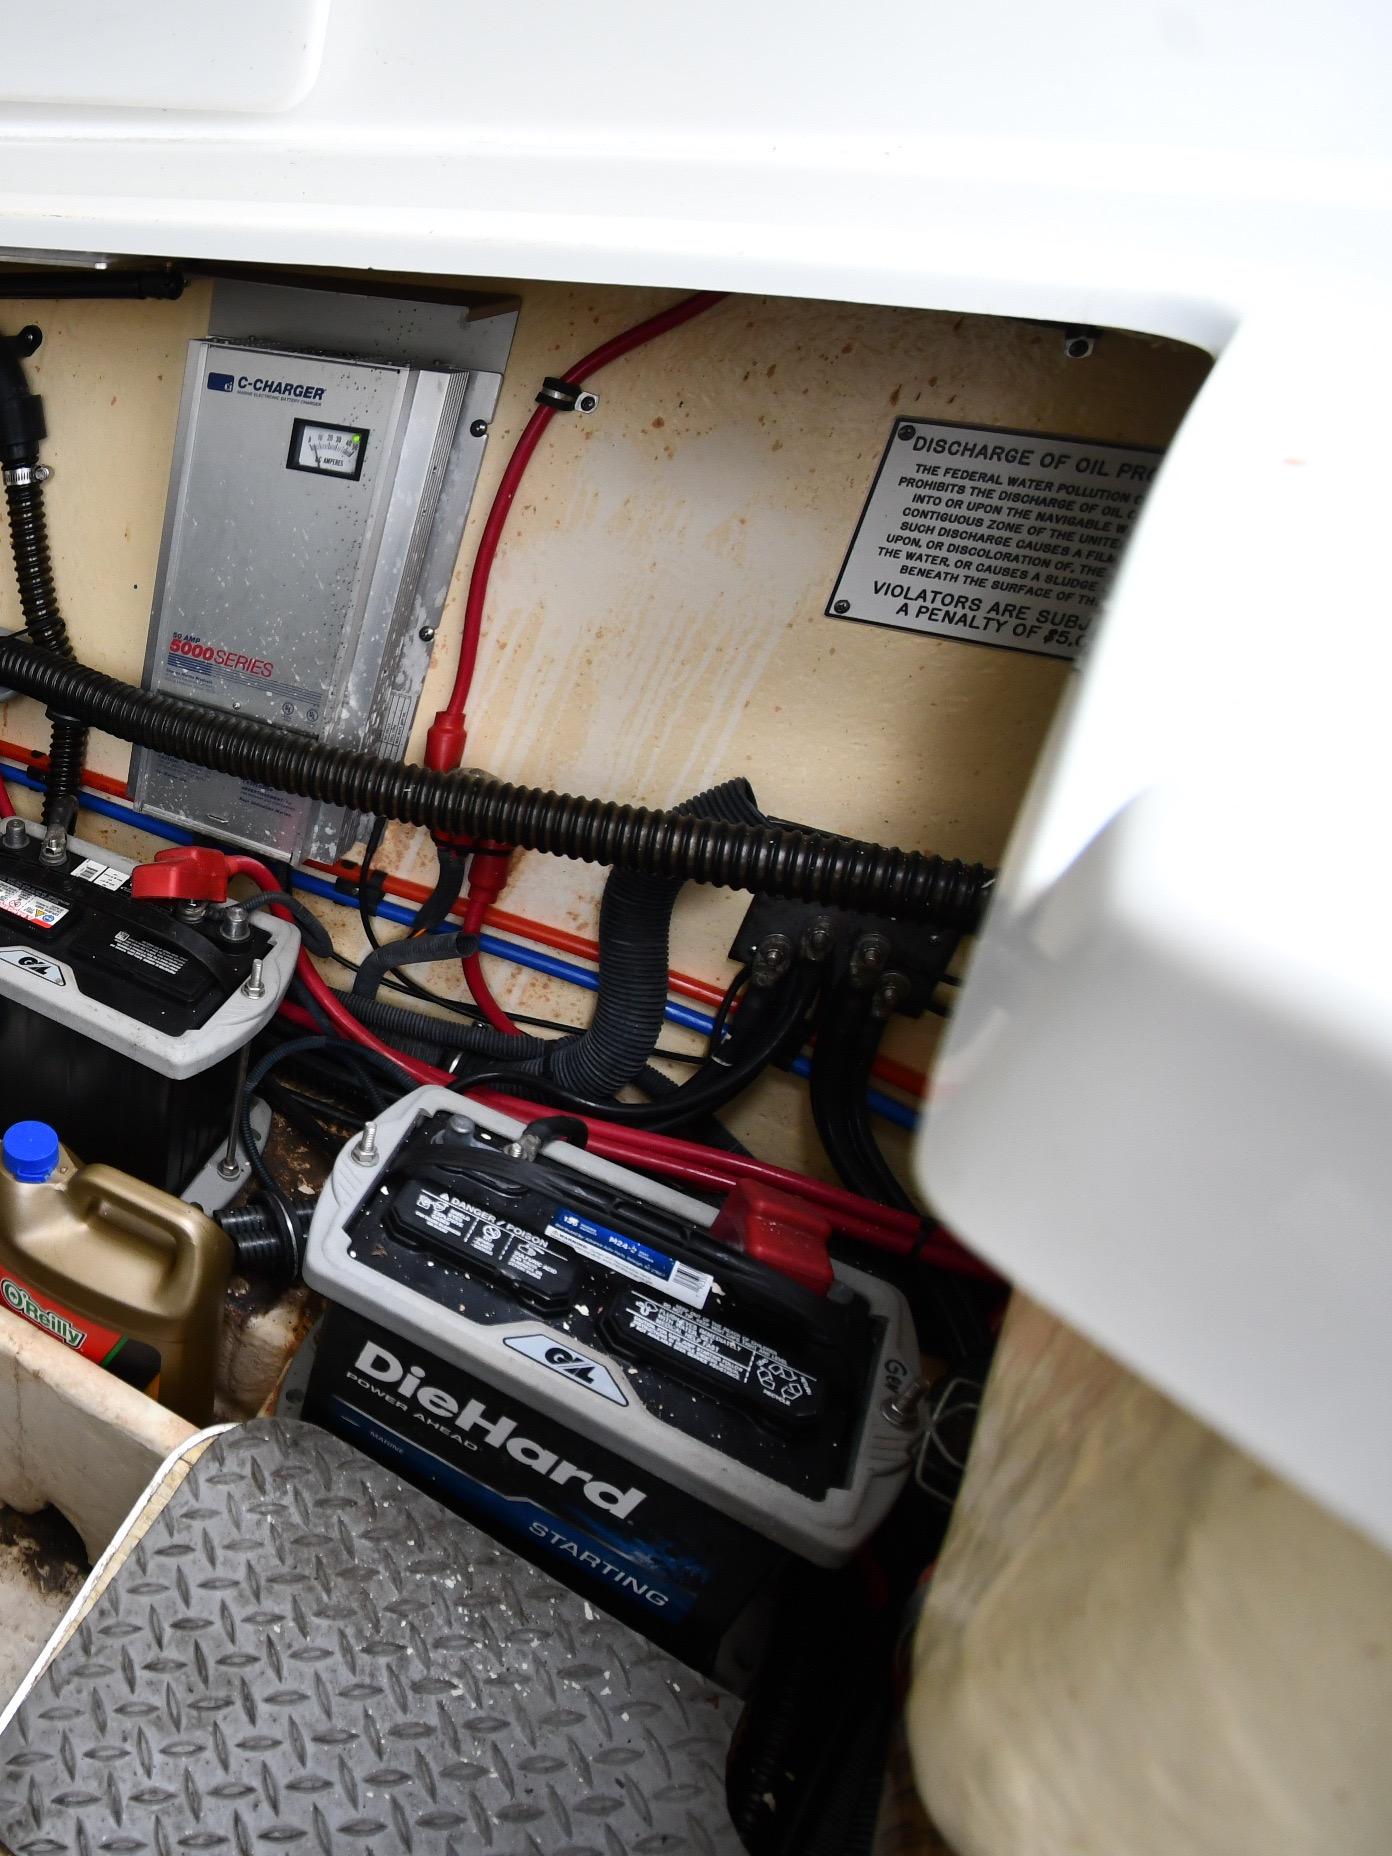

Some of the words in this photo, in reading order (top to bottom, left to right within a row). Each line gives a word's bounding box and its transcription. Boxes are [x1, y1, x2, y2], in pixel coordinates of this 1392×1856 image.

[237, 375, 325, 400] C-CHARGER
[253, 392, 278, 400] ELECTRONIC
[323, 457, 343, 466] AMPERES
[911, 435, 1034, 466] DISCHARGE
[1037, 452, 1071, 471] OF
[1073, 457, 1112, 476] OIL
[897, 476, 966, 495] PROHIBITS
[968, 486, 995, 499] THE
[997, 490, 1075, 511] DISCHARGE
[1078, 502, 1098, 514] OF
[1100, 505, 1123, 518] OIL
[913, 463, 940, 476] THE
[942, 467, 1004, 485] FEDERAL
[1005, 476, 1054, 492] WATER
[1055, 483, 1131, 503] POLLUTION
[901, 506, 984, 528] CONTIGUOUS
[985, 519, 1024, 534] ZONE
[1025, 525, 1046, 537] OF
[1047, 529, 1074, 542] THE
[911, 493, 942, 506] INTO
[944, 498, 964, 509] OR
[965, 501, 1002, 515] UPON
[1004, 507, 1032, 520] THE
[1034, 511, 1112, 532] NAVIGABLE
[899, 521, 935, 535] SUCH
[936, 527, 1013, 547] DISCHARGE
[1014, 539, 1070, 556] CAUSES
[1071, 548, 1082, 558] A
[924, 540, 944, 551] OR
[946, 543, 1052, 569] DISCOLORATION
[1079, 564, 1106, 577] THE
[876, 546, 902, 559] THE
[953, 559, 972, 570] OR
[974, 563, 1028, 580] CAUSES
[1030, 572, 1041, 582] A
[1043, 574, 1098, 592] SLUDGE
[898, 564, 959, 583] BENEATH
[960, 575, 988, 588] THE
[989, 580, 1051, 599] SURFACE
[1054, 591, 1074, 603] OF
[1076, 595, 1098, 607] TH
[870, 580, 982, 612] VIOLATORS
[986, 600, 1030, 621] ARE
[895, 601, 911, 616] A
[915, 605, 1007, 634] PENALTY
[1010, 622, 1042, 640] OF
[183, 634, 200, 644] AMP
[450, 1196, 496, 1223] DANGER
[505, 1223, 549, 1248] POISON
[2, 1278, 83, 1347] O'Reilly
[345, 1371, 408, 1411] POWER
[413, 1411, 479, 1452] AHEAD
[354, 1339, 646, 1519] DieHard
[369, 1430, 404, 1456] MARINE
[528, 1521, 669, 1607] STARTING
